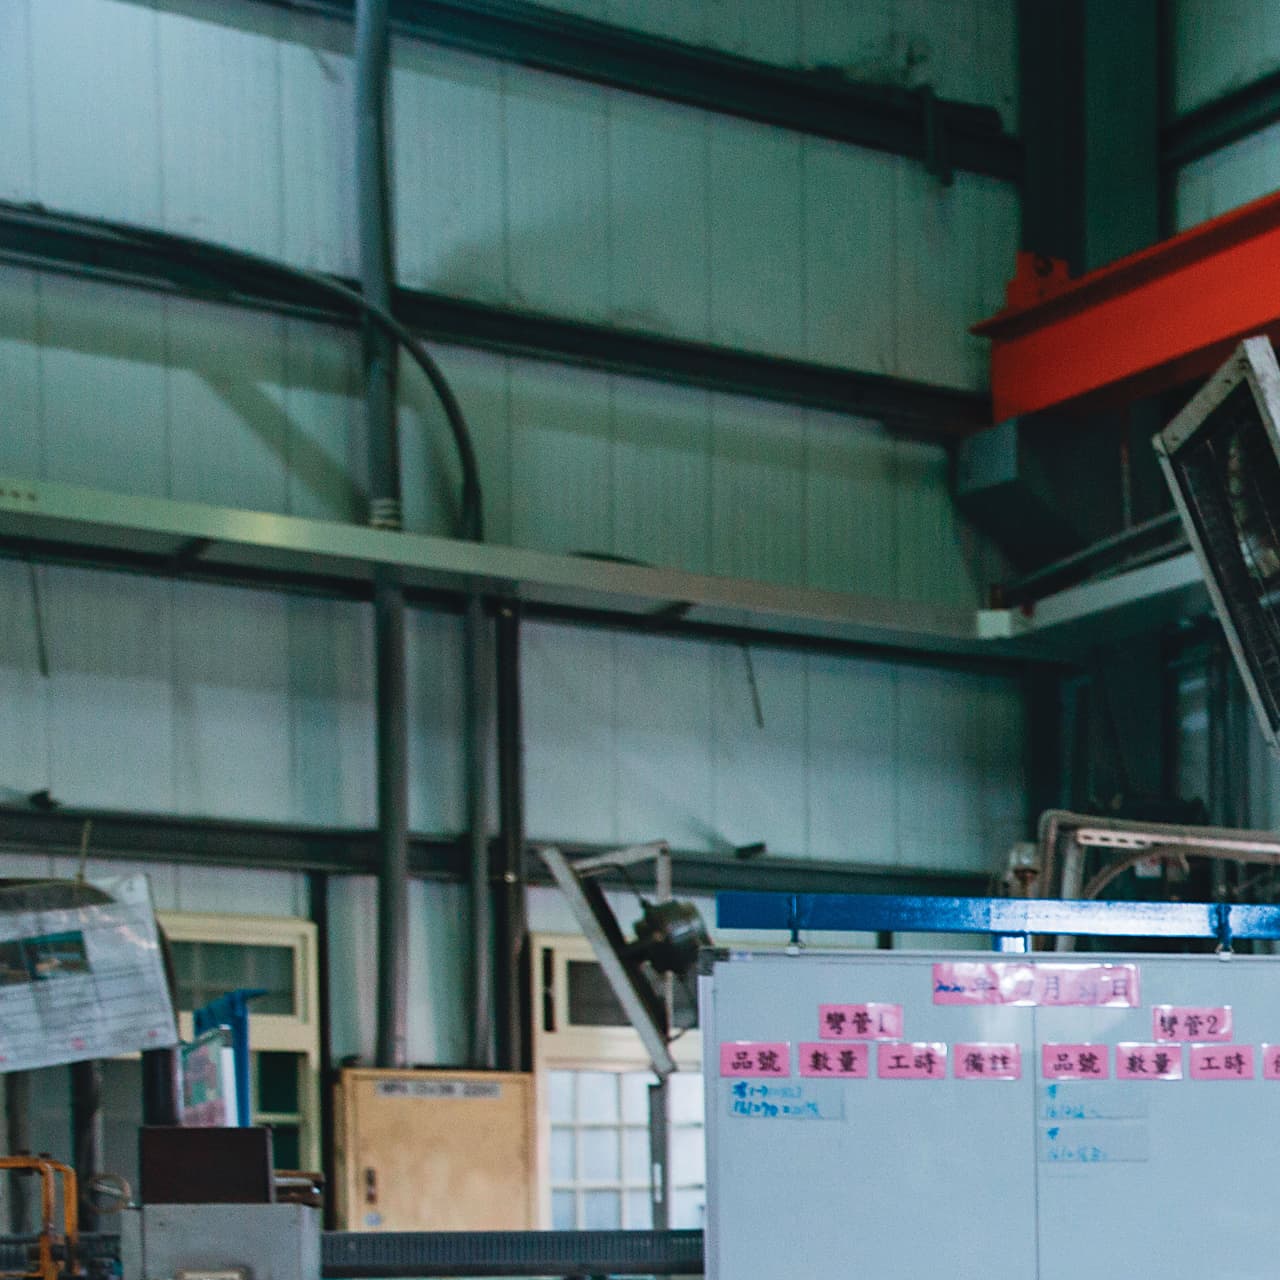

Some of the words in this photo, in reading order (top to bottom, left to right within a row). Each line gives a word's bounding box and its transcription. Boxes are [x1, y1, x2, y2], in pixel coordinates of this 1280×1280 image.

[731, 1051, 781, 1073] 品號
[810, 1050, 858, 1073] 數量
[888, 1052, 937, 1074] 工時
[964, 1051, 1011, 1073] 備註
[1053, 1052, 1100, 1074] 品號
[1126, 1052, 1172, 1075] 數量
[1200, 1053, 1246, 1075] 工時
